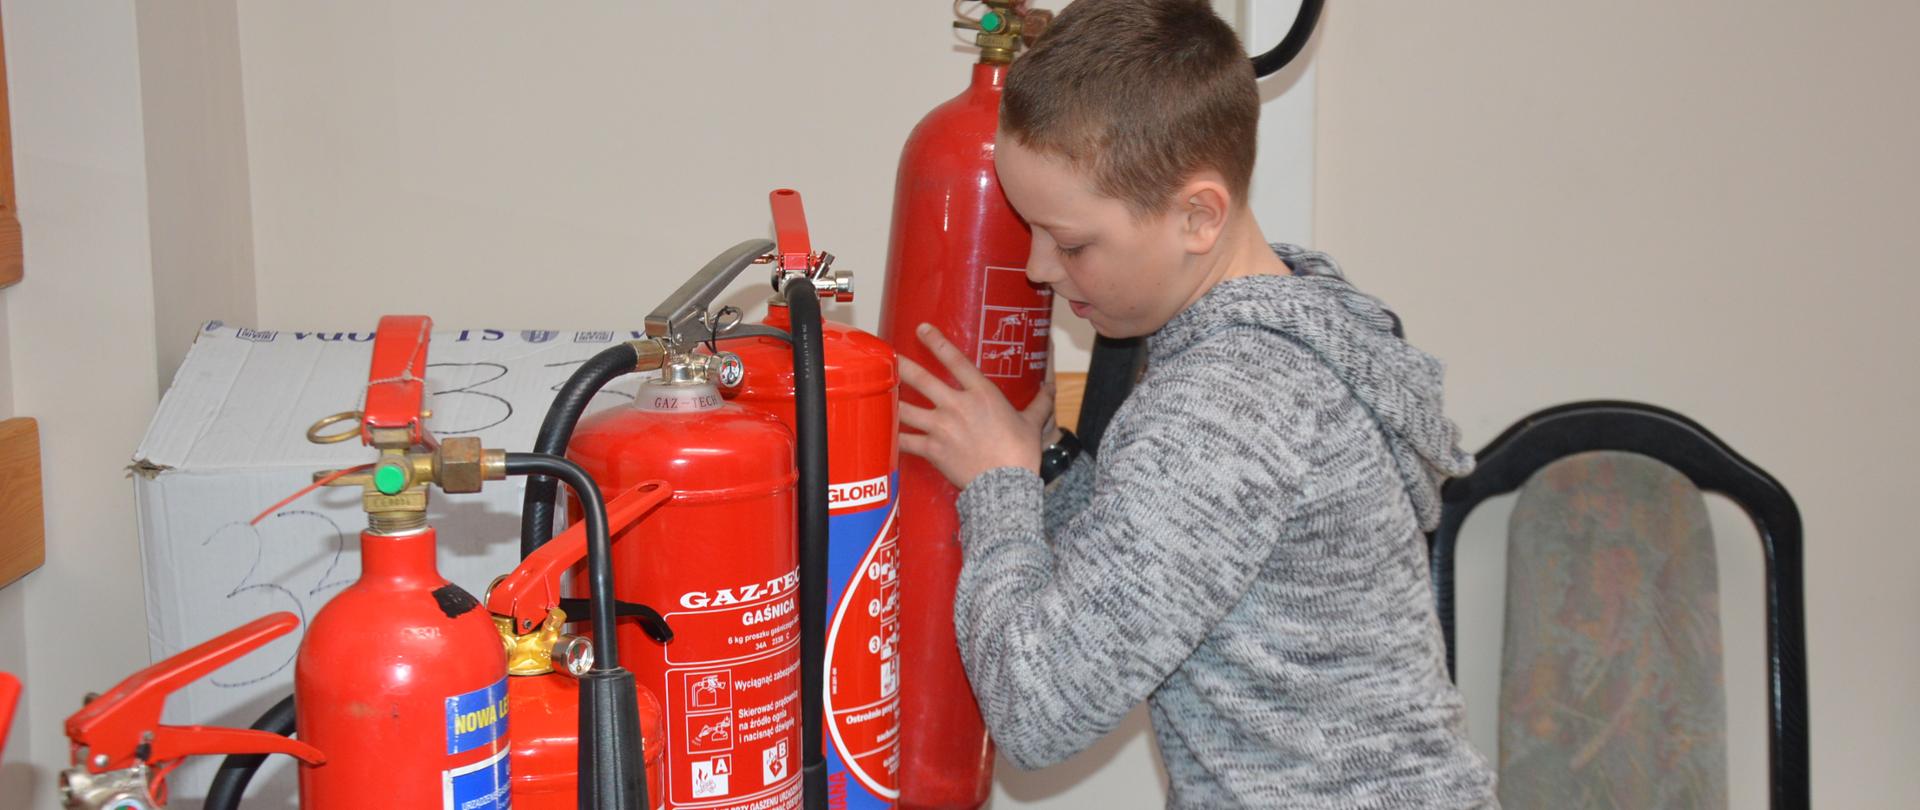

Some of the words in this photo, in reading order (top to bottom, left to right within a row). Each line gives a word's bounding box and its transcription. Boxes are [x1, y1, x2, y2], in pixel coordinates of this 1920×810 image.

[828, 481, 886, 503] GLORIA
[742, 598, 795, 626] GAŚNICA
[734, 635, 744, 645] kg
[744, 629, 770, 643] proszku
[734, 672, 774, 691] Wyciągnąć
[738, 701, 774, 718] Skierować
[455, 704, 498, 735] NOWA
[738, 721, 749, 732] na
[779, 742, 787, 757] B
[715, 758, 729, 774] A
